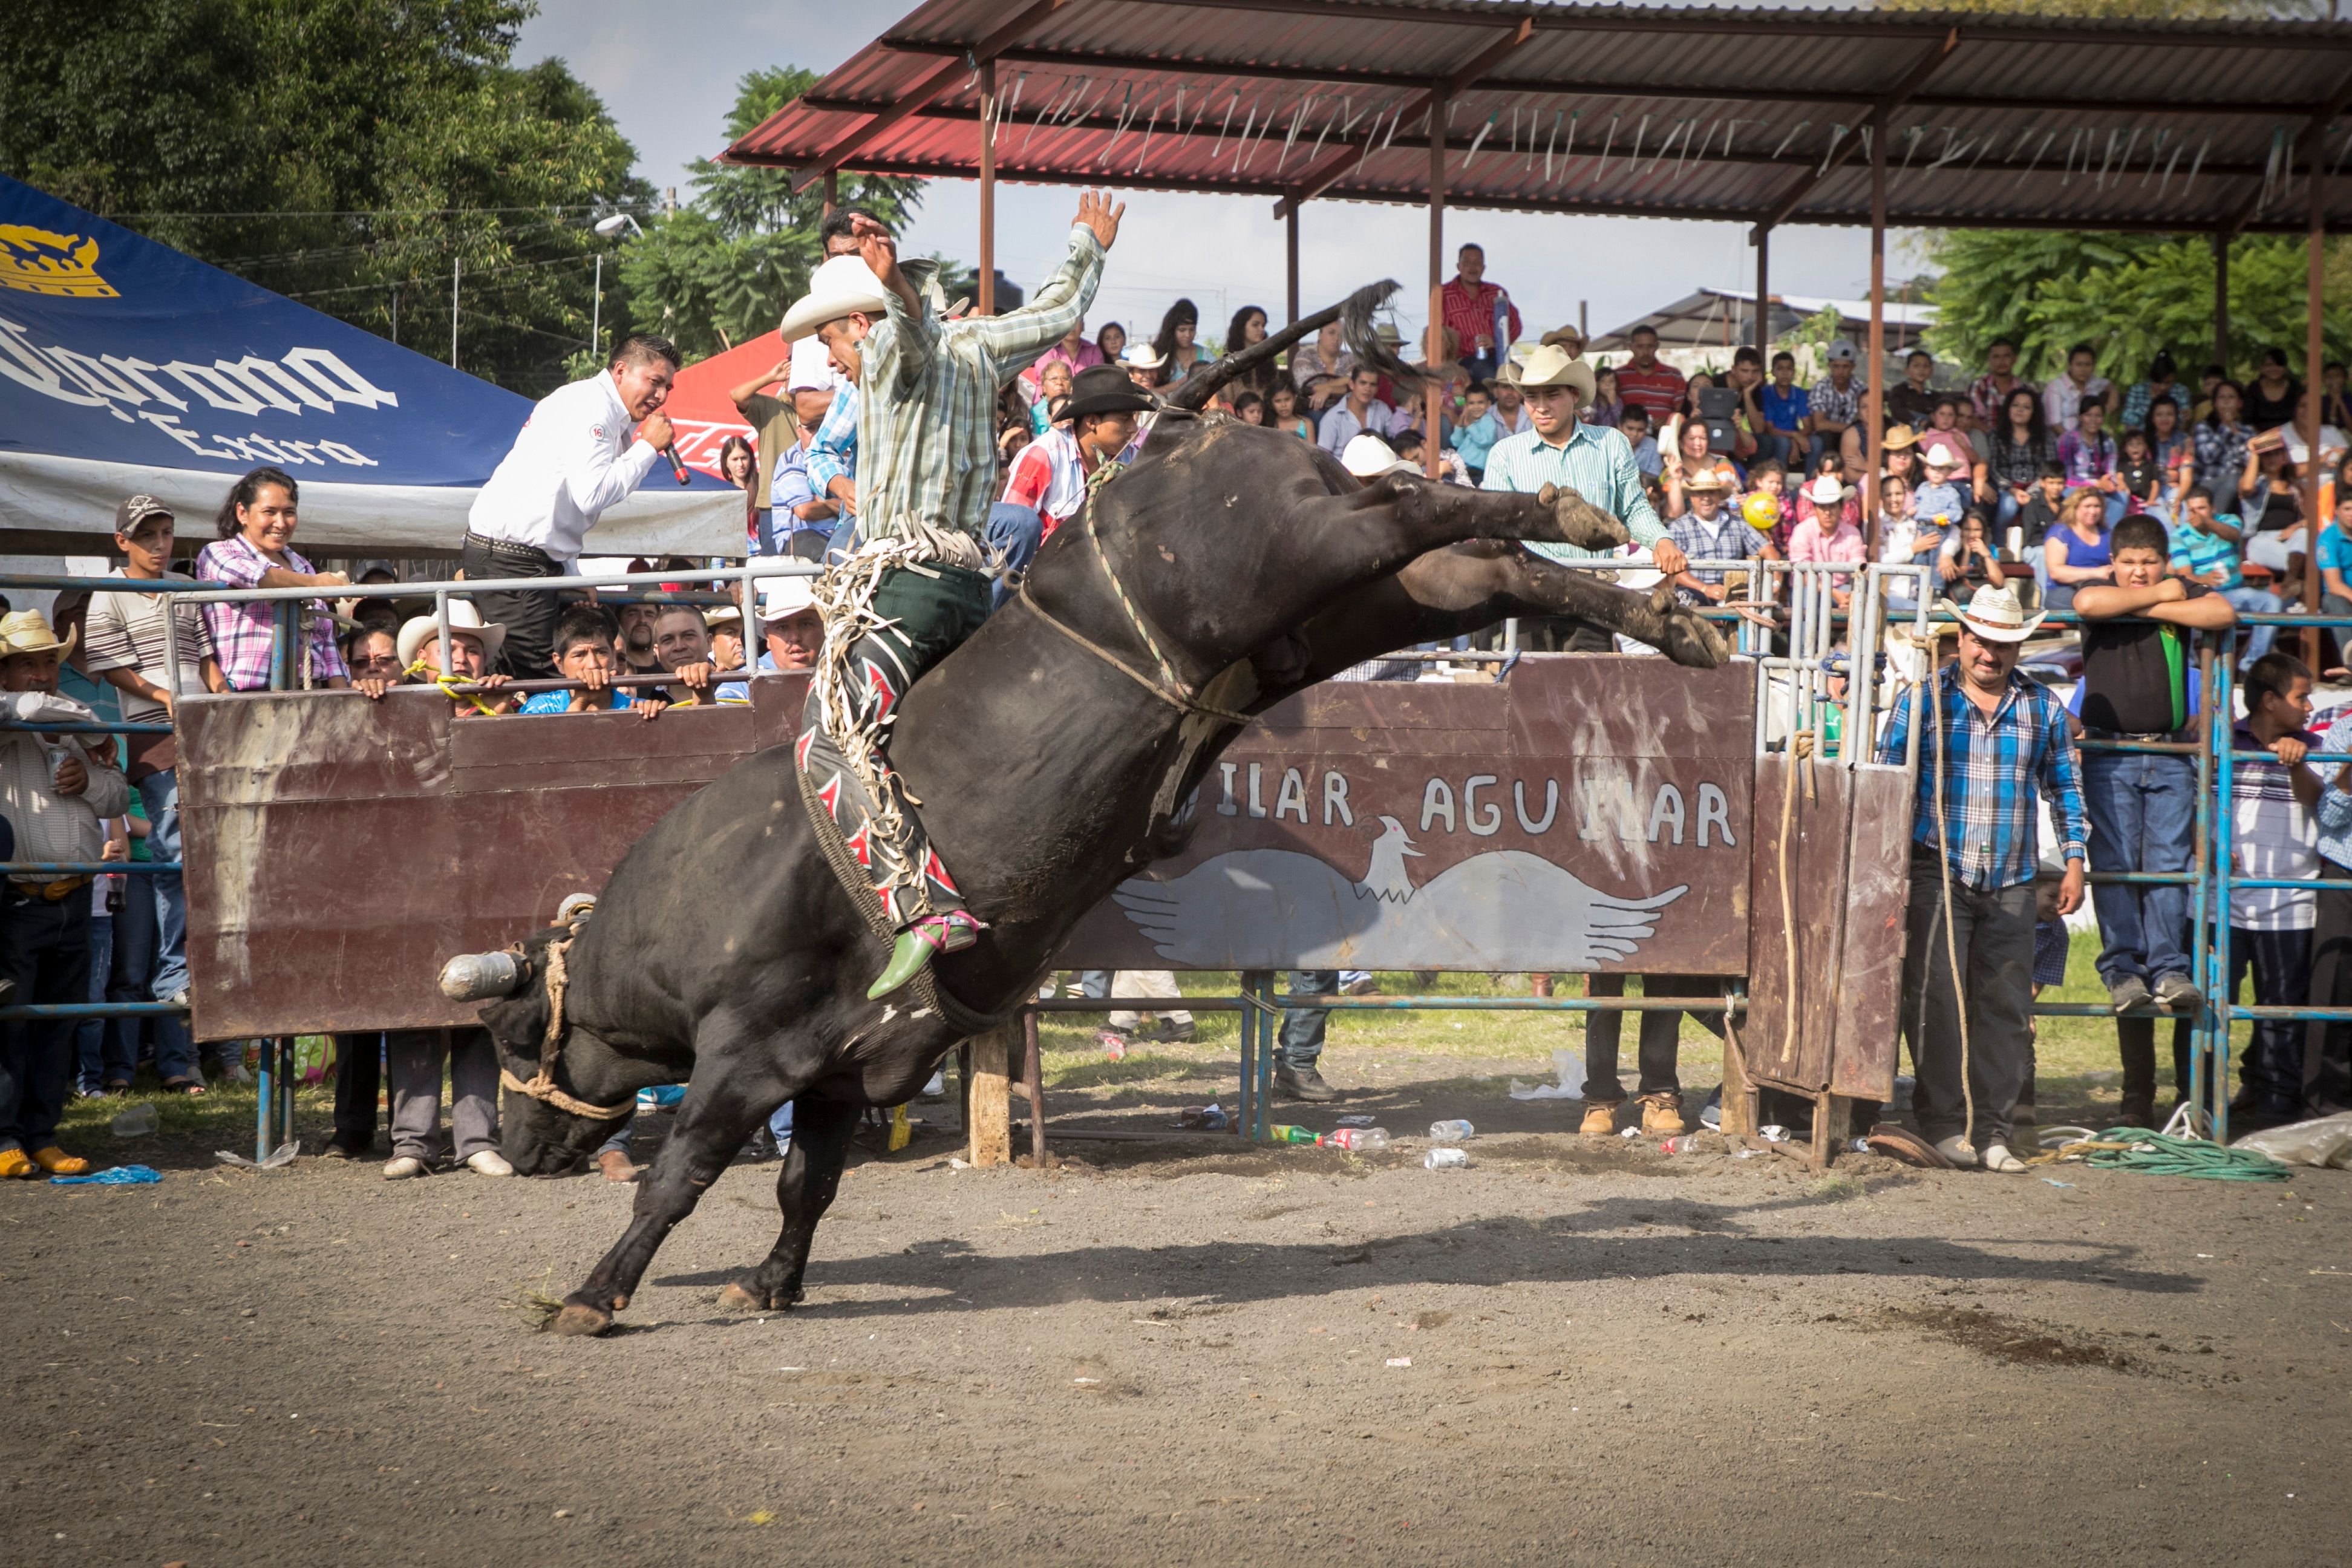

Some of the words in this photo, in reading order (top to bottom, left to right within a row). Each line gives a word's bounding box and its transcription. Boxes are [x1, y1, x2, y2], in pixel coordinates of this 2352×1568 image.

[138, 410, 378, 466] Extra
[593, 428, 602, 437] 16
[1171, 761, 1354, 826] ILAR
[1419, 774, 1737, 847] AGUILAR
